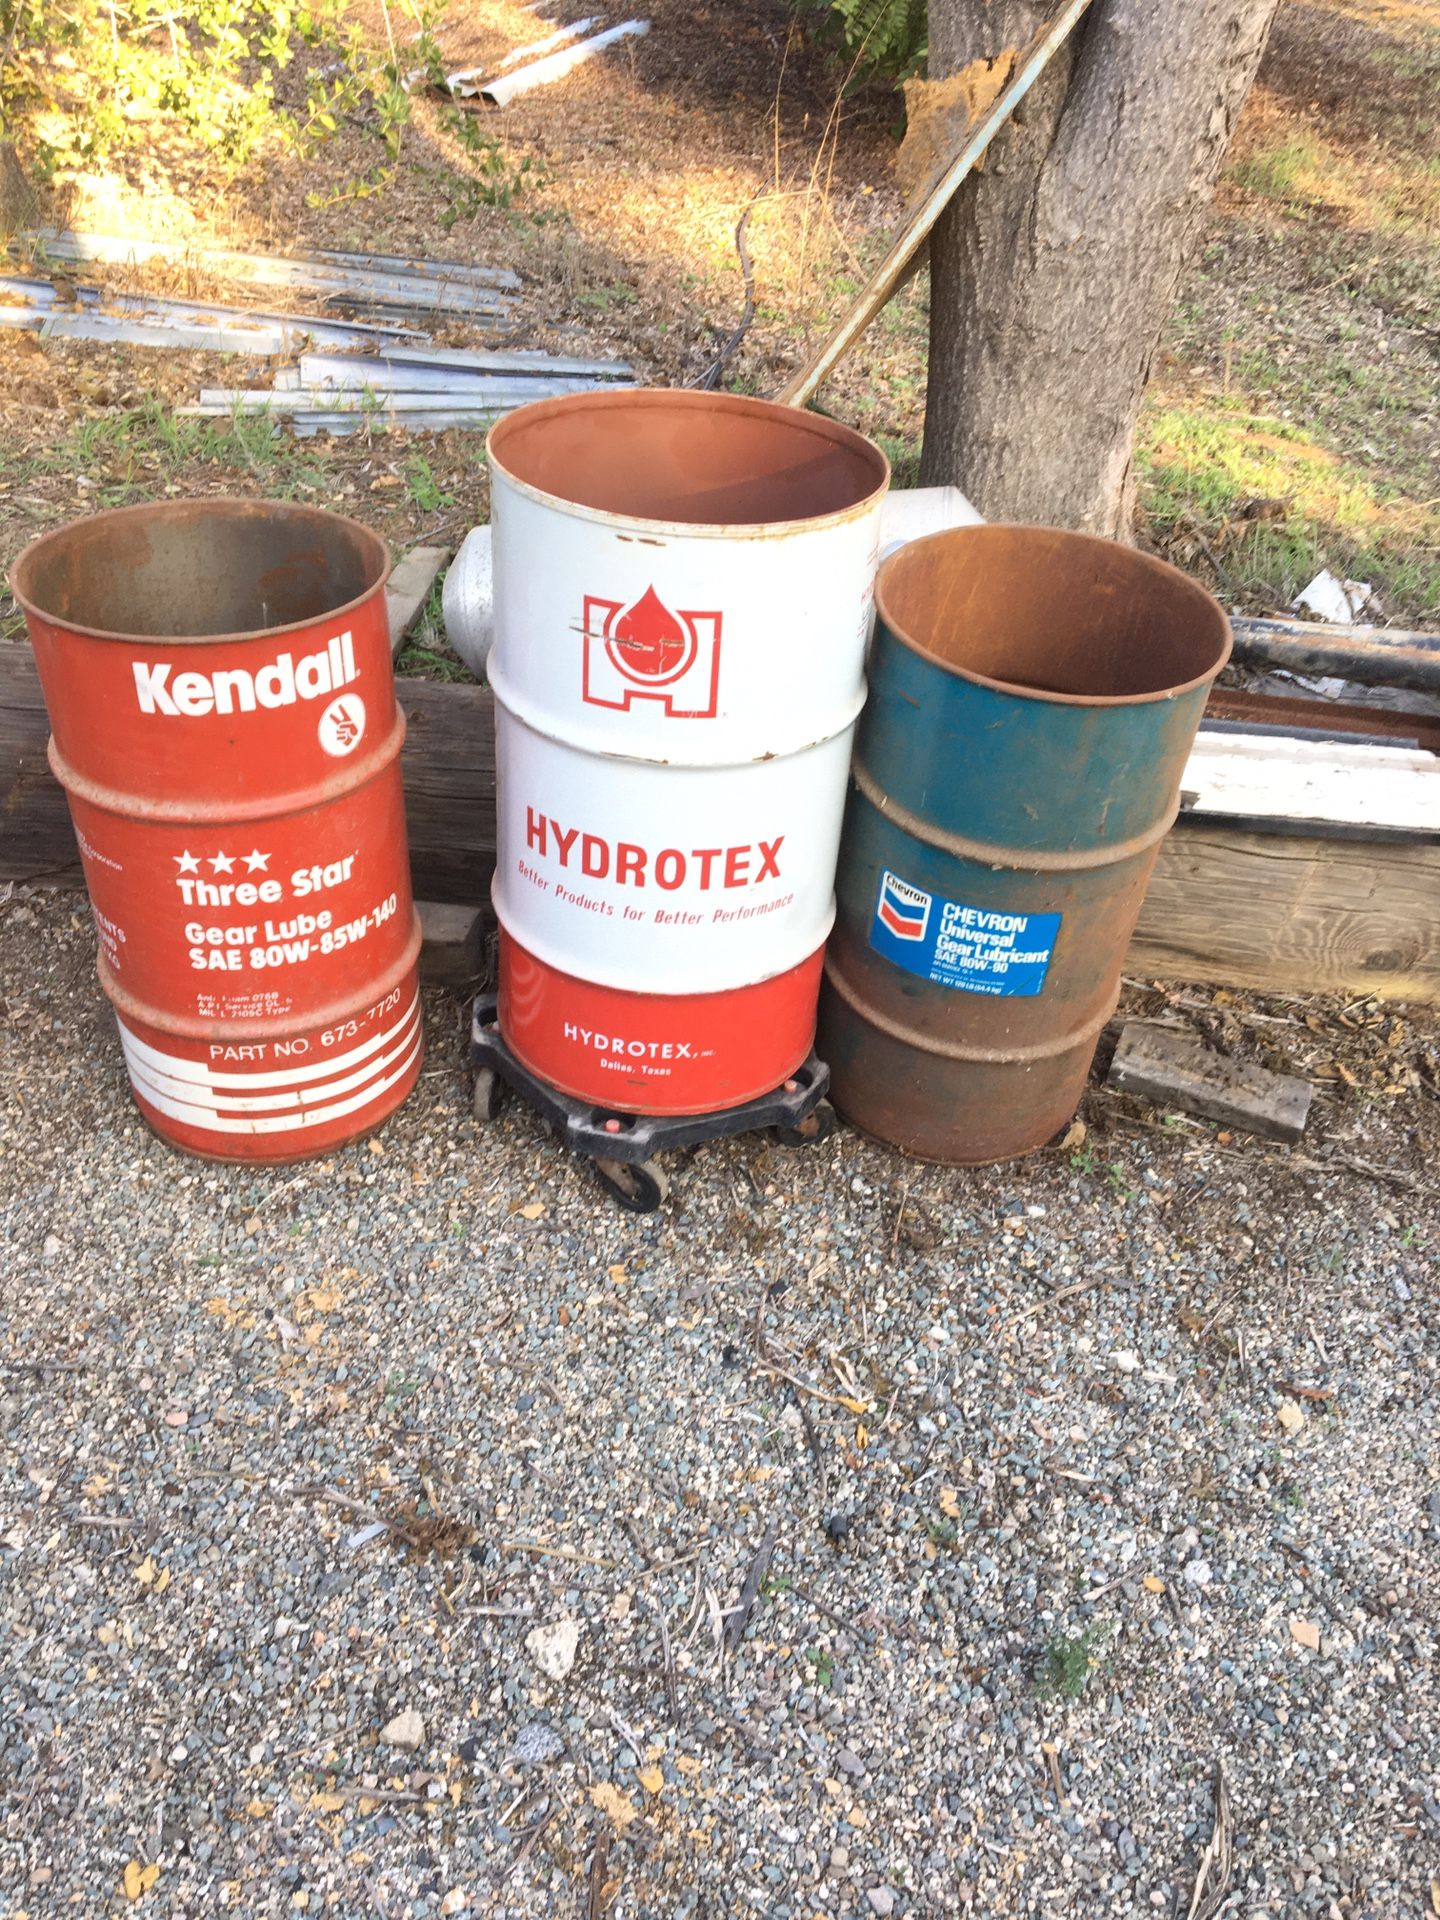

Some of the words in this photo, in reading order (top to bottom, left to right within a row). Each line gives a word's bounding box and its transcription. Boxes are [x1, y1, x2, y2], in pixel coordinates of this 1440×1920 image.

[132, 630, 356, 717] Kendall
[526, 805, 786, 891] HYDROTEX
[176, 878, 283, 907] Three
[290, 855, 354, 897] Star
[518, 859, 550, 891] Better
[554, 884, 615, 917] Products
[623, 905, 646, 922] for
[653, 909, 705, 926] Better
[712, 892, 795, 924] Performance
[886, 873, 928, 906] Chevron
[184, 922, 258, 946] Gear
[264, 909, 333, 943] Lube
[188, 947, 243, 971] SAE
[249, 892, 398, 970] 80W-85W-140
[939, 917, 1016, 949] Universal
[942, 902, 1029, 934] CHEVRON
[934, 948, 958, 965] SAE
[959, 956, 1009, 974] 80W-90
[936, 933, 975, 959] Gear
[974, 943, 1050, 964] Lubricant
[210, 1044, 268, 1061] PART
[320, 987, 401, 1048] 673-7720
[564, 1021, 698, 1060] HYDROTEX,
[600, 1057, 636, 1074] Dallas,
[641, 1064, 672, 1076] Texas
